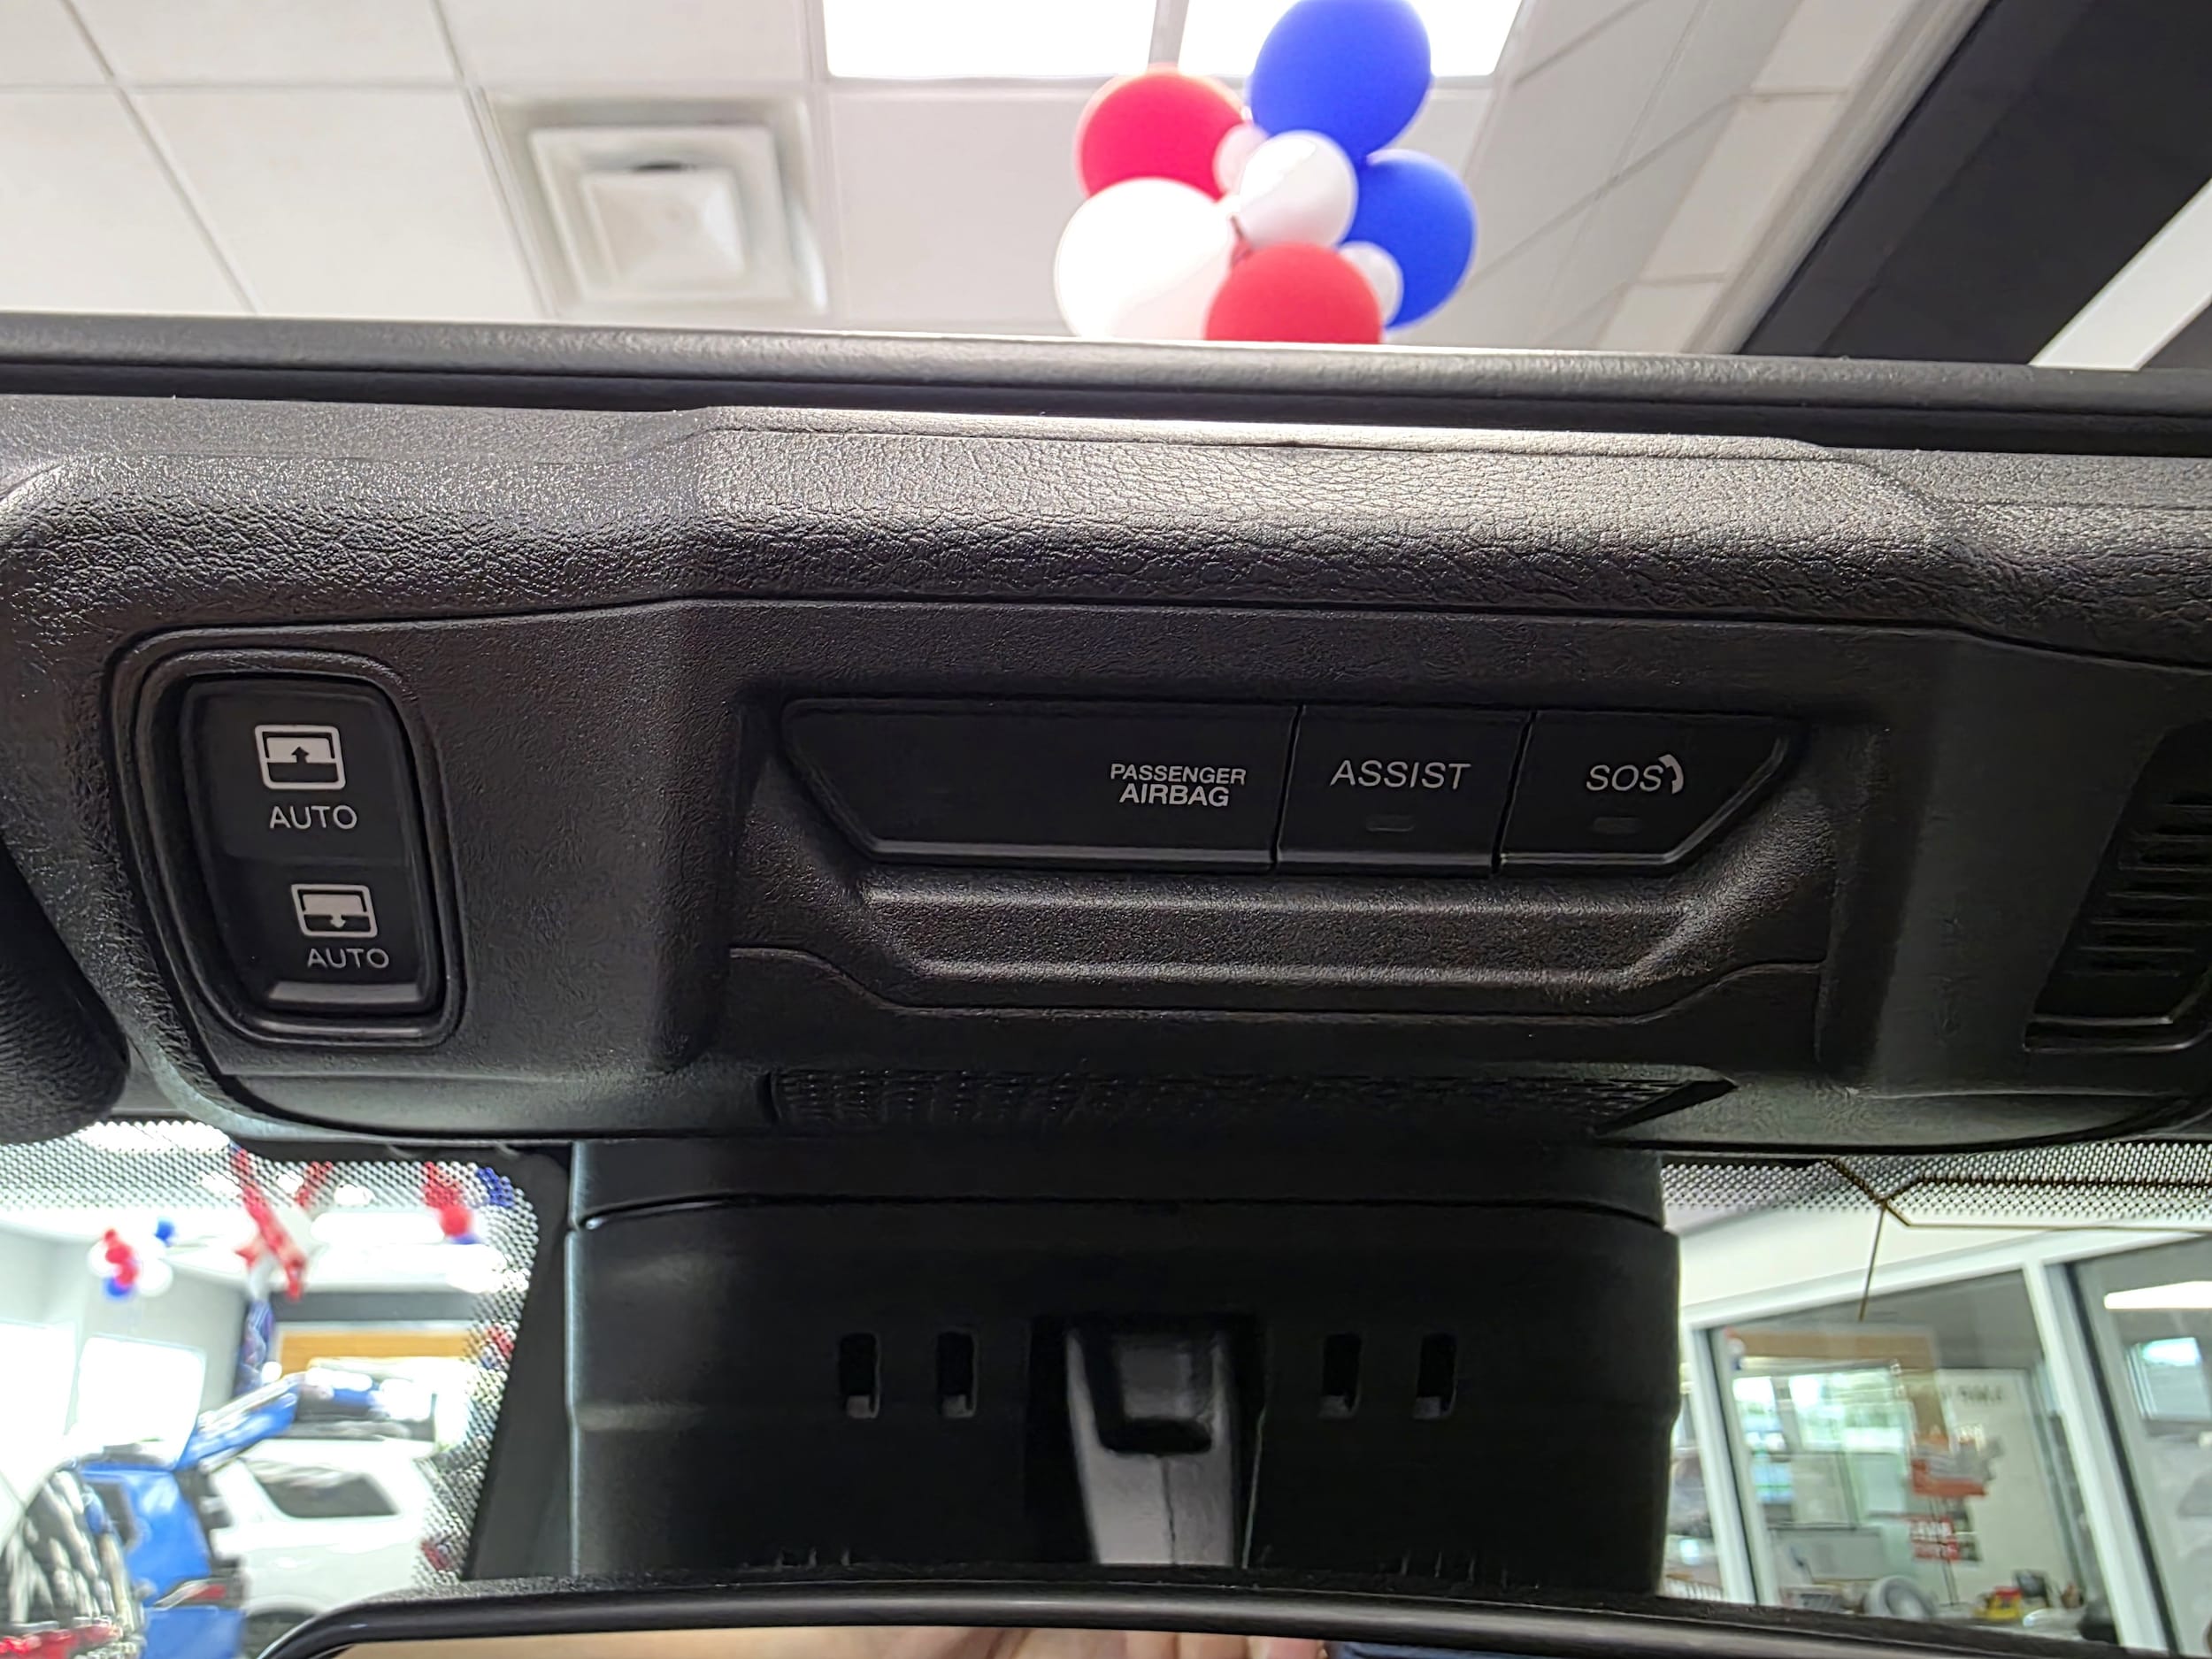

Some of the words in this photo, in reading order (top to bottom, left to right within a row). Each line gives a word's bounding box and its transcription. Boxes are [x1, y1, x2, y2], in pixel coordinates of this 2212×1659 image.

[1110, 764, 1247, 786] PASSENGER
[1329, 760, 1471, 790] ASSIST
[1586, 764, 1663, 792] SOS
[1119, 783, 1229, 807] AIRBAG
[269, 805, 357, 829] AUTO
[307, 948, 389, 968] AUTO
